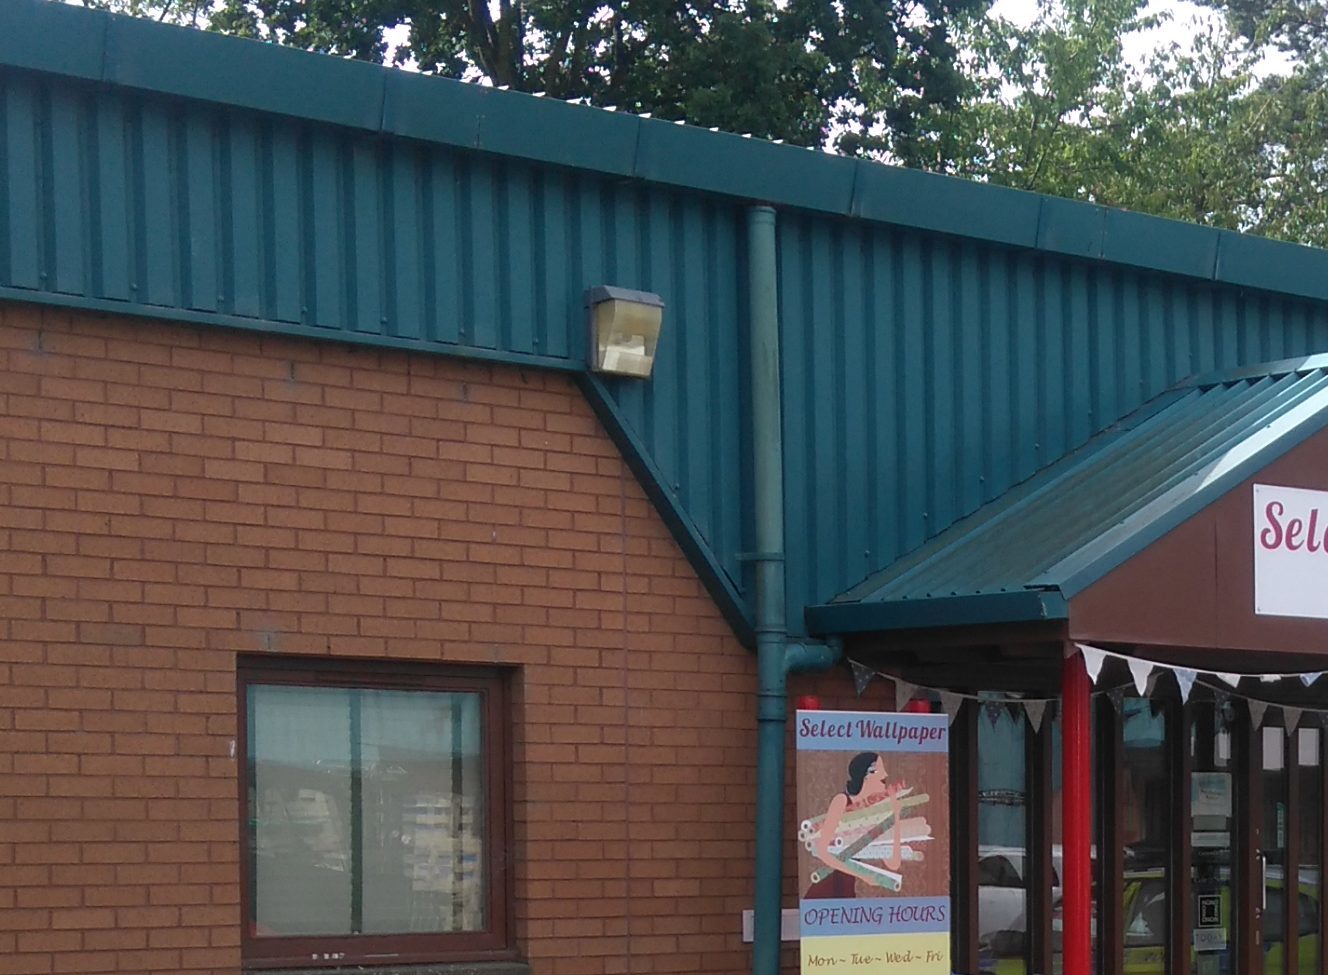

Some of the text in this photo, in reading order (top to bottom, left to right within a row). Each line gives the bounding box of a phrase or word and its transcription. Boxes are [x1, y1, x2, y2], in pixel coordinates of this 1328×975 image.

[800, 718, 946, 744] Select Wallpaper
[804, 904, 946, 926] OPENING HOURS
[808, 954, 837, 967] Mon
[850, 953, 874, 965] Tue
[886, 951, 914, 964] Wed
[926, 950, 944, 963] Fri
